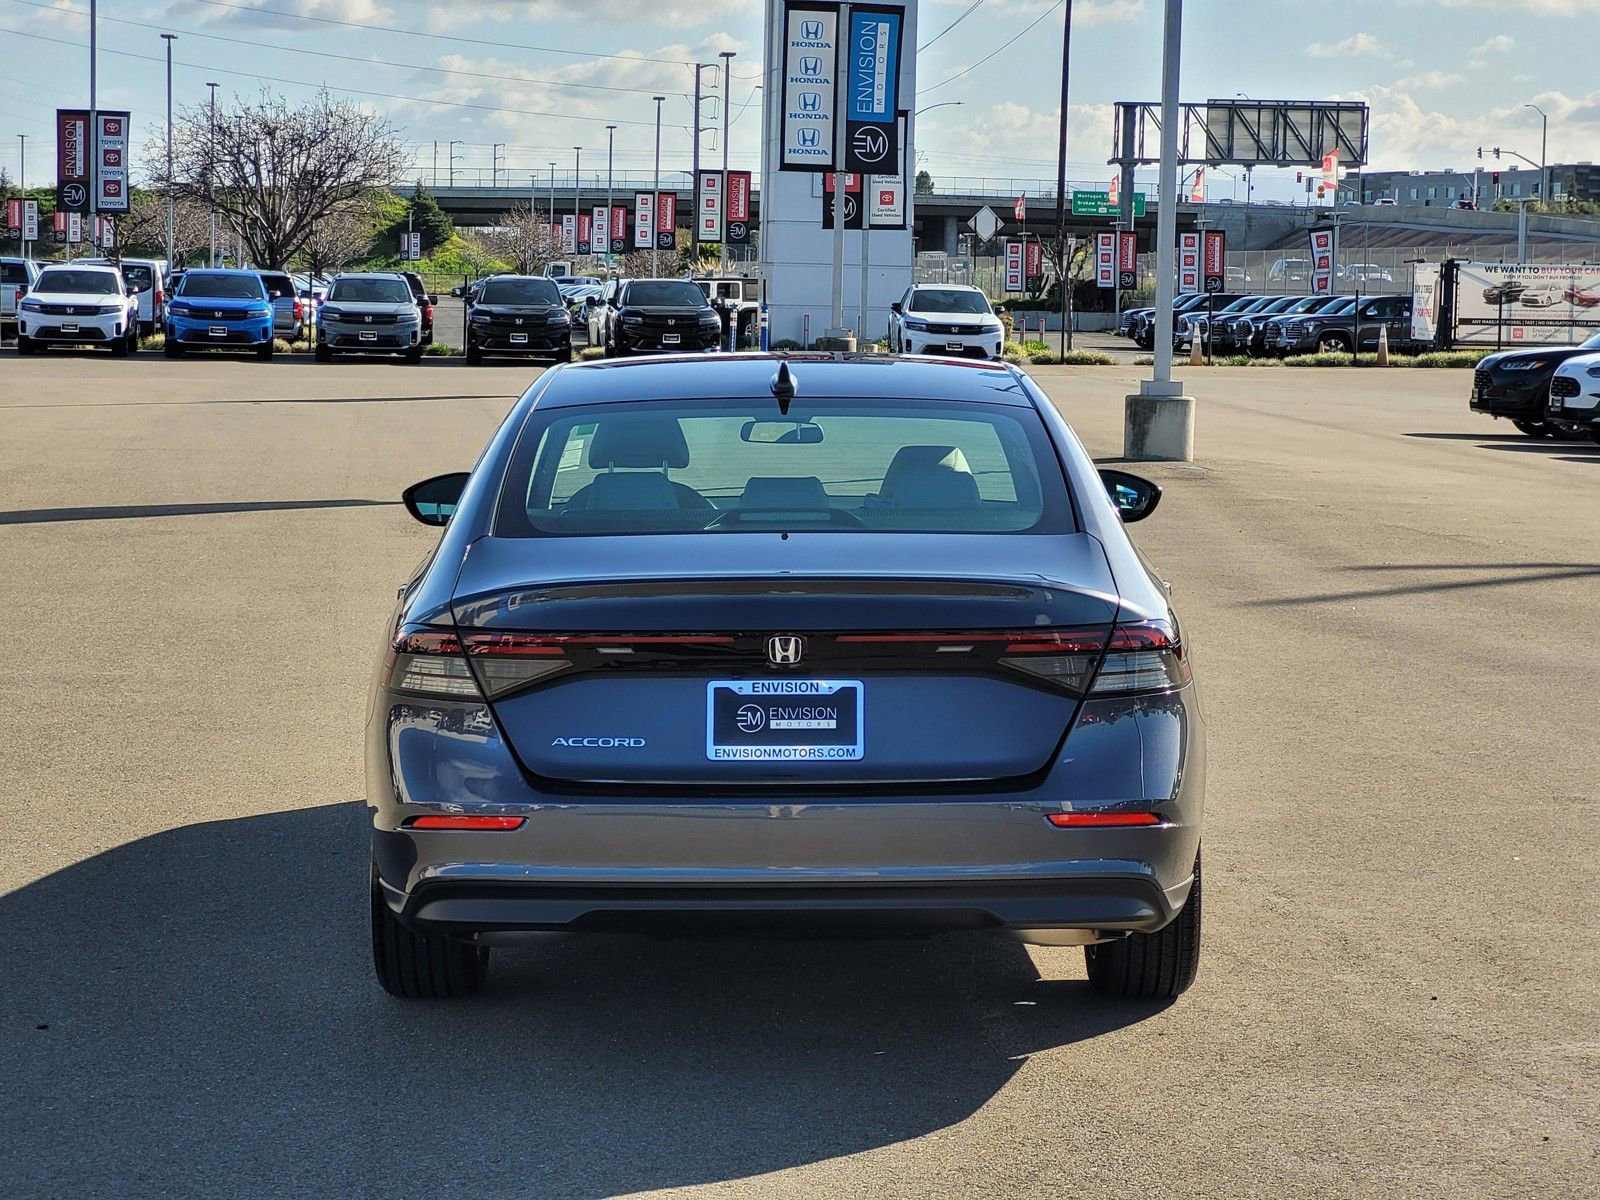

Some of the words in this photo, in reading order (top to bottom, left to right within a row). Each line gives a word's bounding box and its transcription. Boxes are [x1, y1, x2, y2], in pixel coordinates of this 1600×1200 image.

[791, 41, 832, 49] HONDA
[856, 21, 878, 113] ENVISION
[876, 31, 887, 106] MOTORS
[788, 112, 829, 120] HONDA
[65, 120, 76, 176] ENVISION
[788, 148, 829, 156] HONDA
[731, 177, 740, 218] ENVISION
[1207, 236, 1215, 273] ENVISION
[1500, 266, 1526, 274] WANT
[1560, 267, 1583, 275] YOUR
[752, 682, 819, 693] ENVISION
[769, 707, 837, 719] ENVISION
[551, 737, 646, 747] ACCORD
[714, 748, 856, 758] ENVISIONMOTORS.COM
